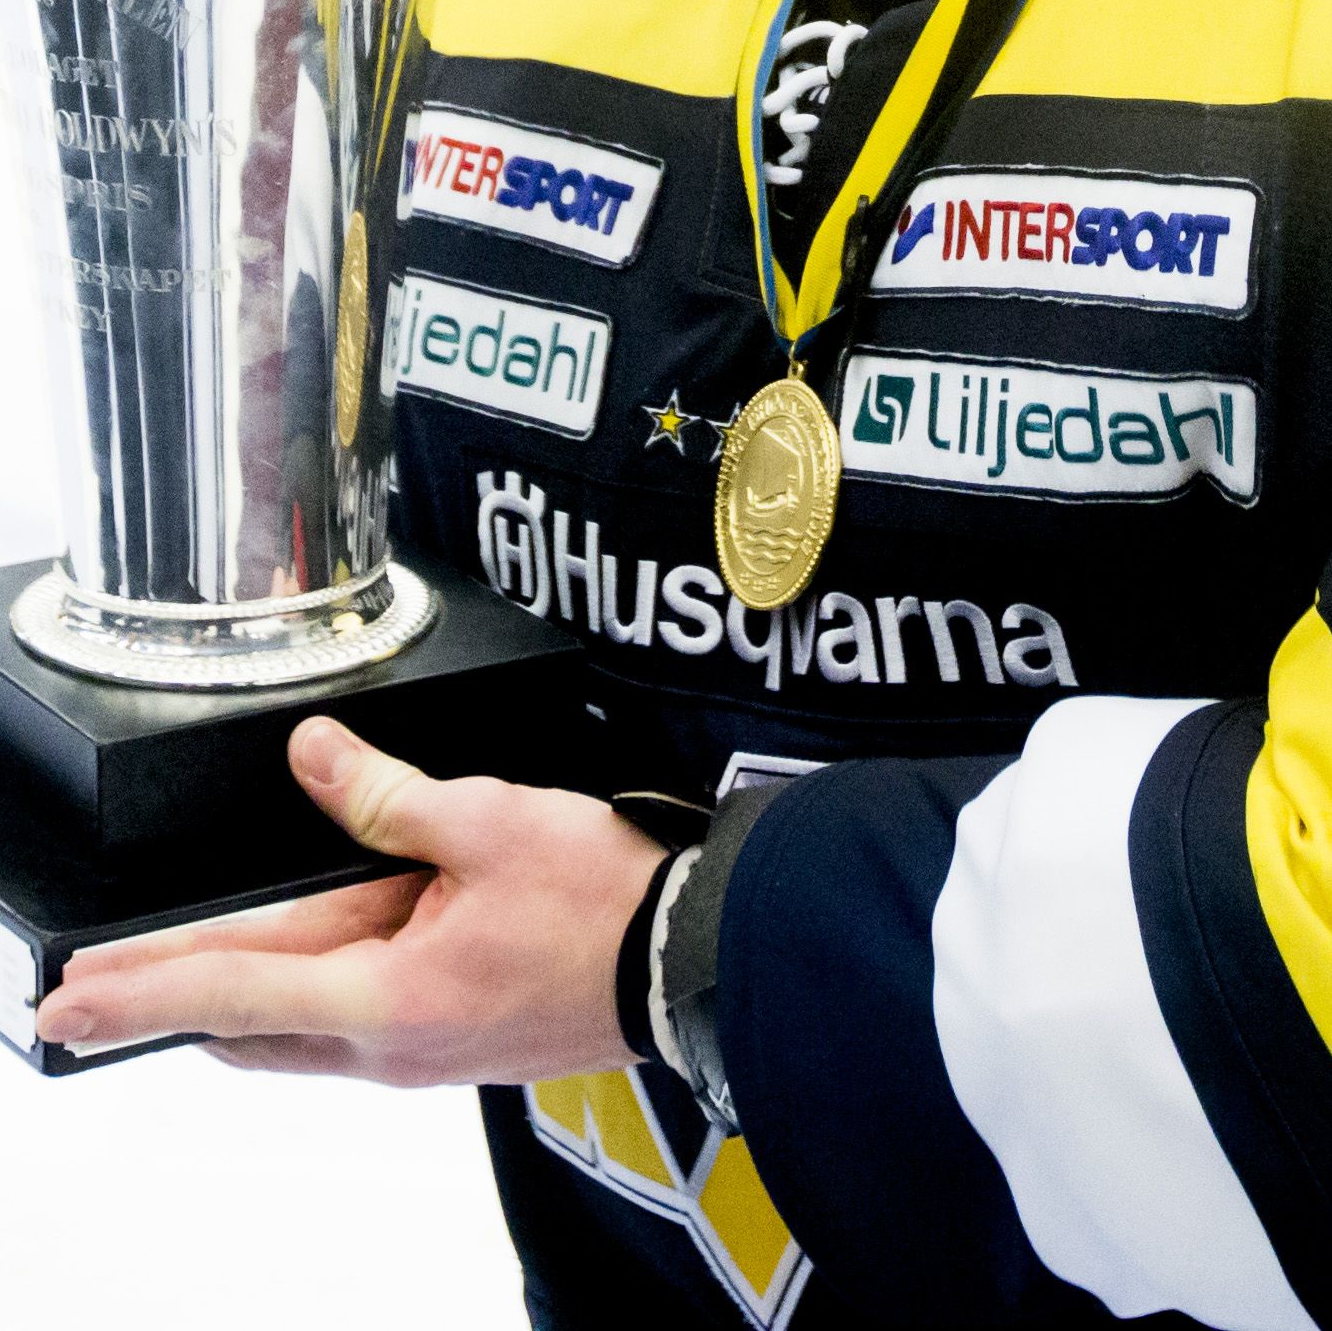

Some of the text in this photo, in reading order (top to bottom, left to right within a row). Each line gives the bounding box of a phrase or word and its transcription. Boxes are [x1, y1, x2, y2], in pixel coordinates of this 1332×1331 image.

[942, 198, 1231, 278] INTERSPORT
[928, 372, 1235, 479] Liljedahl
[554, 509, 1080, 691] Husqvarna
